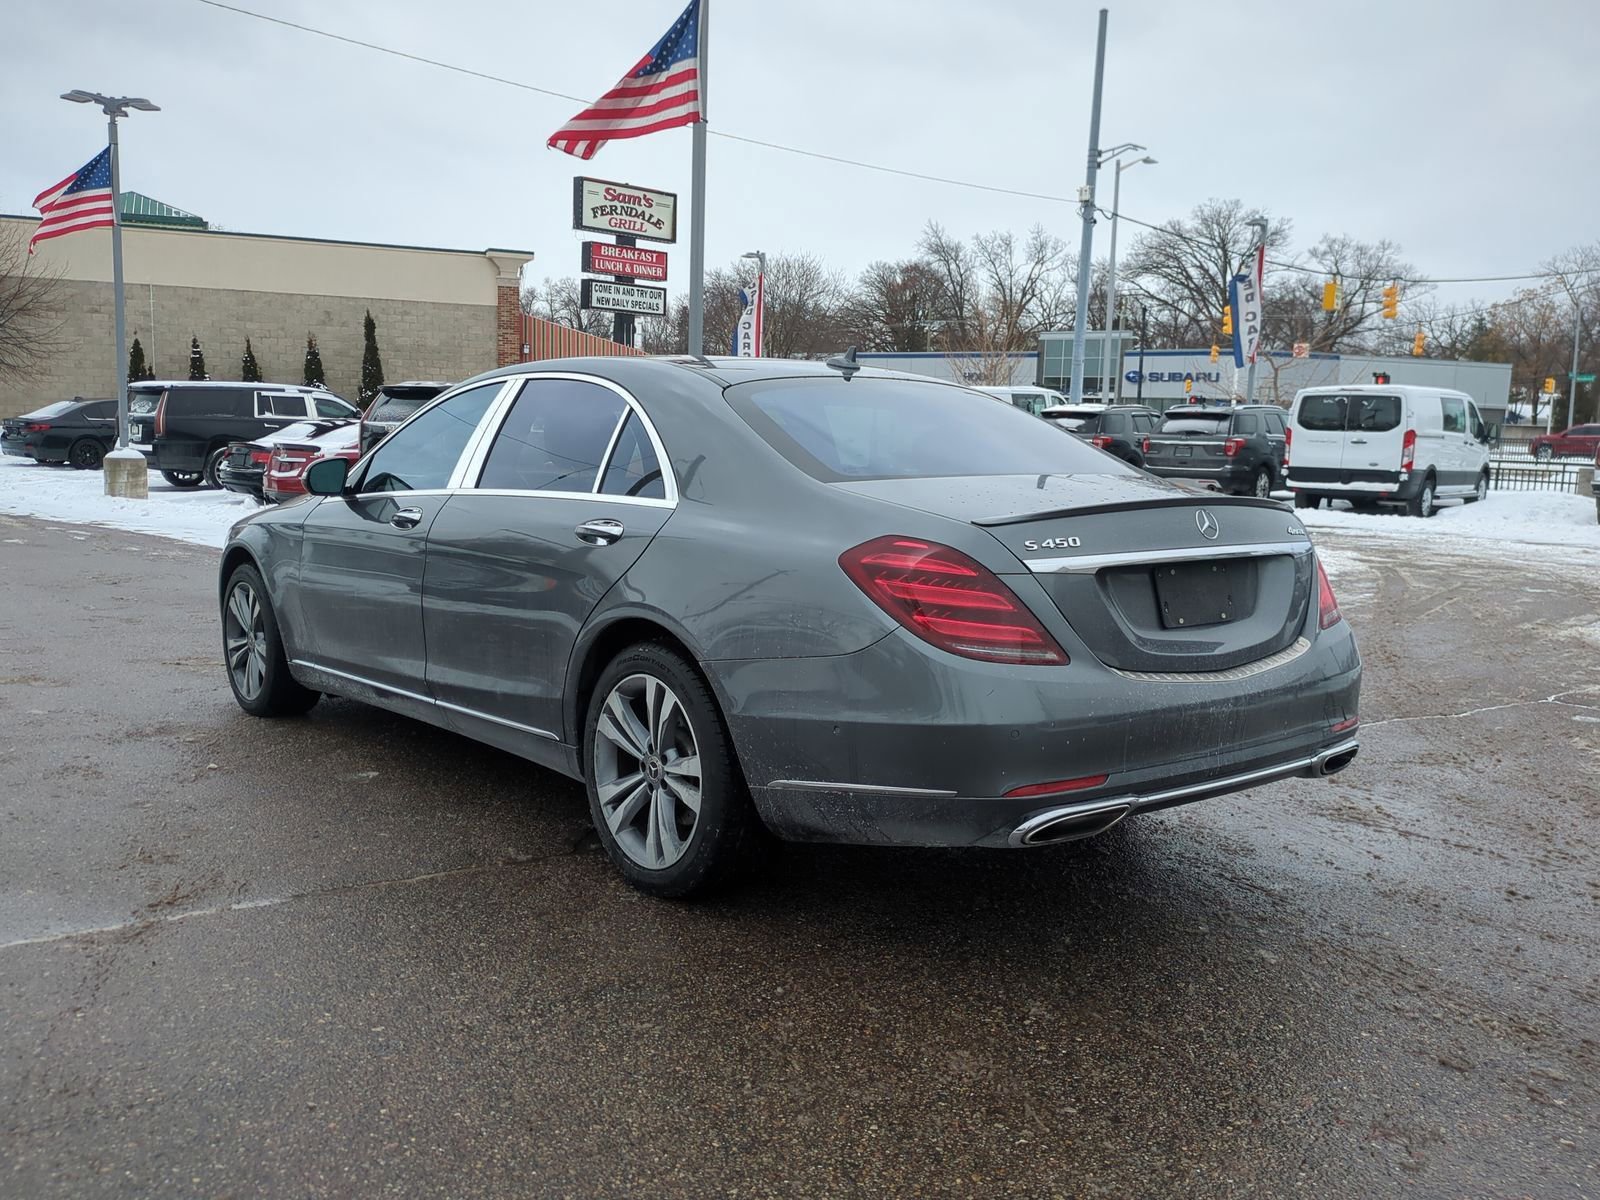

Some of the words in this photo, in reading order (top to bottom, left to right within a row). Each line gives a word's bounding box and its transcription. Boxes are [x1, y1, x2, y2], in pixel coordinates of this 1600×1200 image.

[603, 187, 654, 209] Sam's
[590, 204, 665, 230] FERNDALE
[608, 216, 647, 233] GRILL
[601, 245, 658, 263] BREAKFAST
[595, 259, 623, 272] LUNCH
[625, 265, 632, 273] &
[633, 265, 663, 277] DINNER
[594, 283, 612, 295] COME
[614, 286, 620, 295] IN
[622, 287, 635, 297] AND
[636, 288, 649, 299] TRY
[649, 290, 662, 300] OUR
[596, 296, 611, 306] NEW
[612, 298, 630, 309] DAILY
[631, 300, 660, 312] SPECIALS
[1148, 372, 1220, 383] SUBARU
[1024, 540, 1038, 551] S
[1041, 536, 1081, 549] 450
